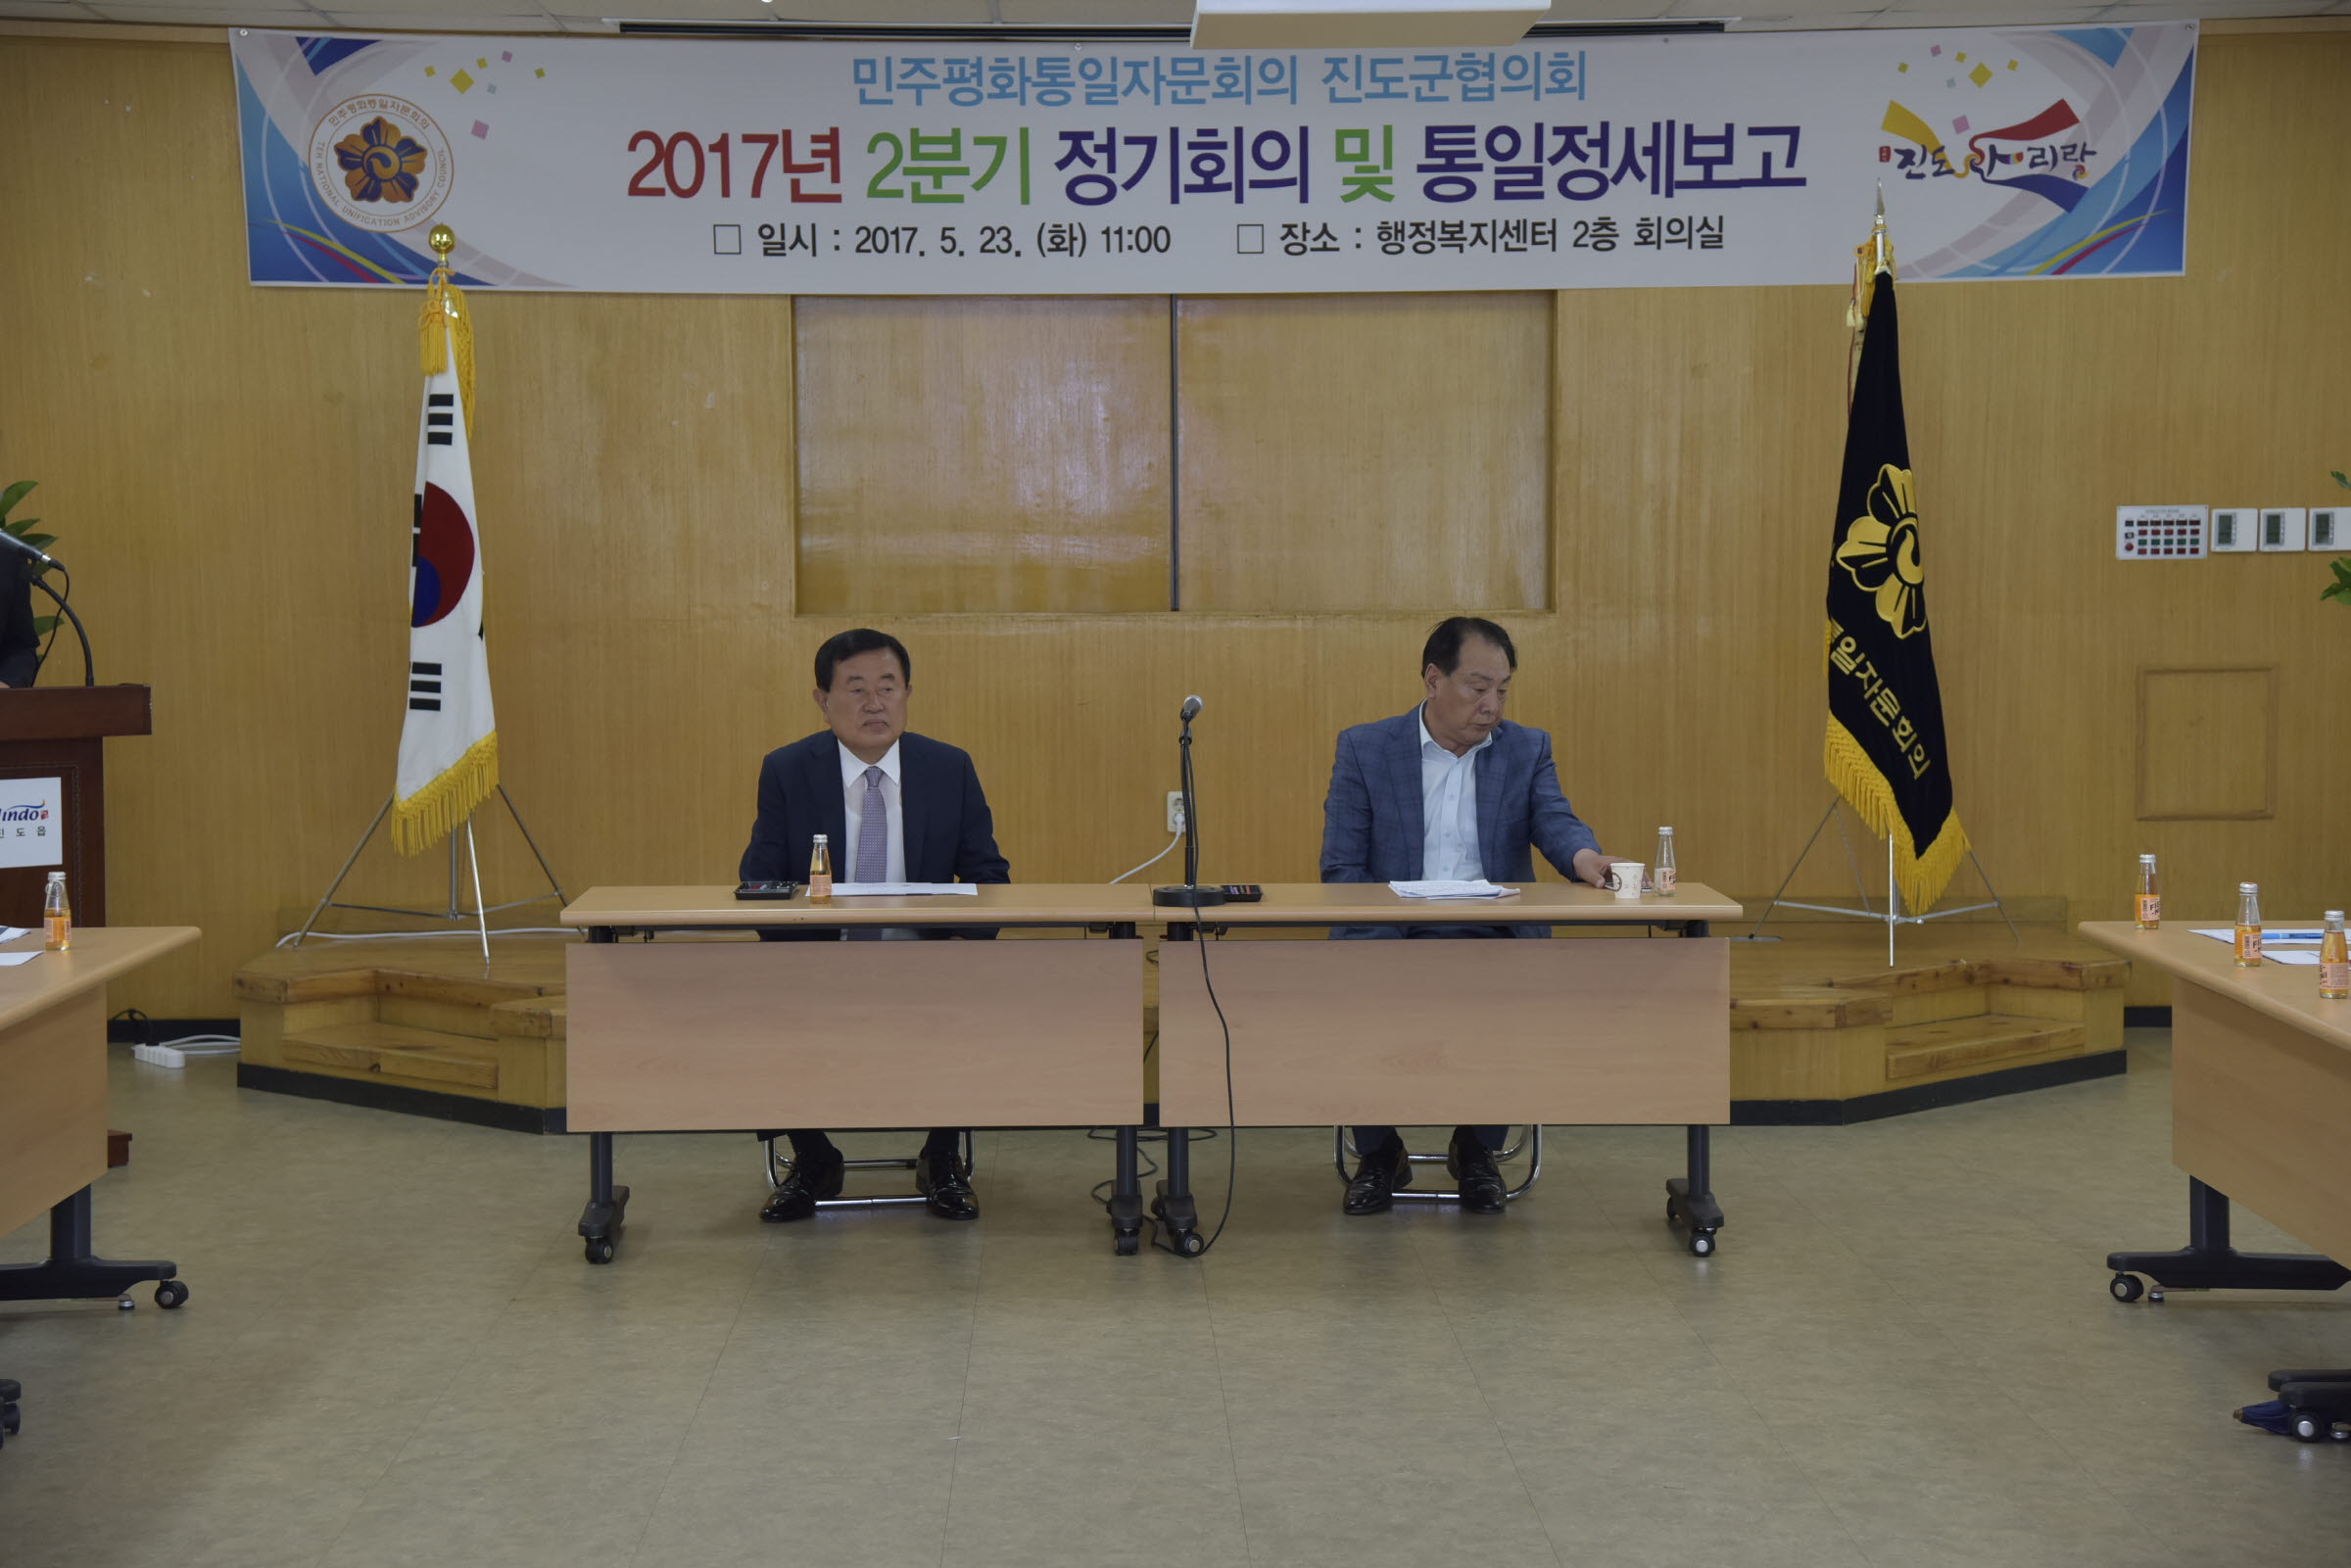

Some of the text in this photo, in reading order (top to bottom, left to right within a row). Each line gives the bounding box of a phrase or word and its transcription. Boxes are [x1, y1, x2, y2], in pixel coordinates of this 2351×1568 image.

[853, 50, 1587, 107] 민주평화통일자문회의 진도군협의회
[328, 99, 430, 130] 민주평화통일자문회의
[627, 119, 1807, 206] 2017년 2분기 정기회의 및 통일정세보고
[315, 163, 340, 206] NATIONAL
[342, 206, 401, 227] UNIFICATION
[405, 190, 440, 222] ADVISORY
[437, 148, 448, 188] COUNCIL
[758, 223, 817, 257] 일시
[855, 226, 925, 257] 2017.
[940, 226, 965, 257] 5.
[980, 226, 1021, 257] 23.
[1036, 222, 1087, 258] (화)
[1101, 225, 1172, 253] 11:00
[1280, 221, 1341, 256] 장소
[1377, 218, 1557, 255] 행정복지센터
[1573, 216, 1620, 252] 2층
[1634, 215, 1724, 251] 회의실
[0, 808, 39, 822] indo
